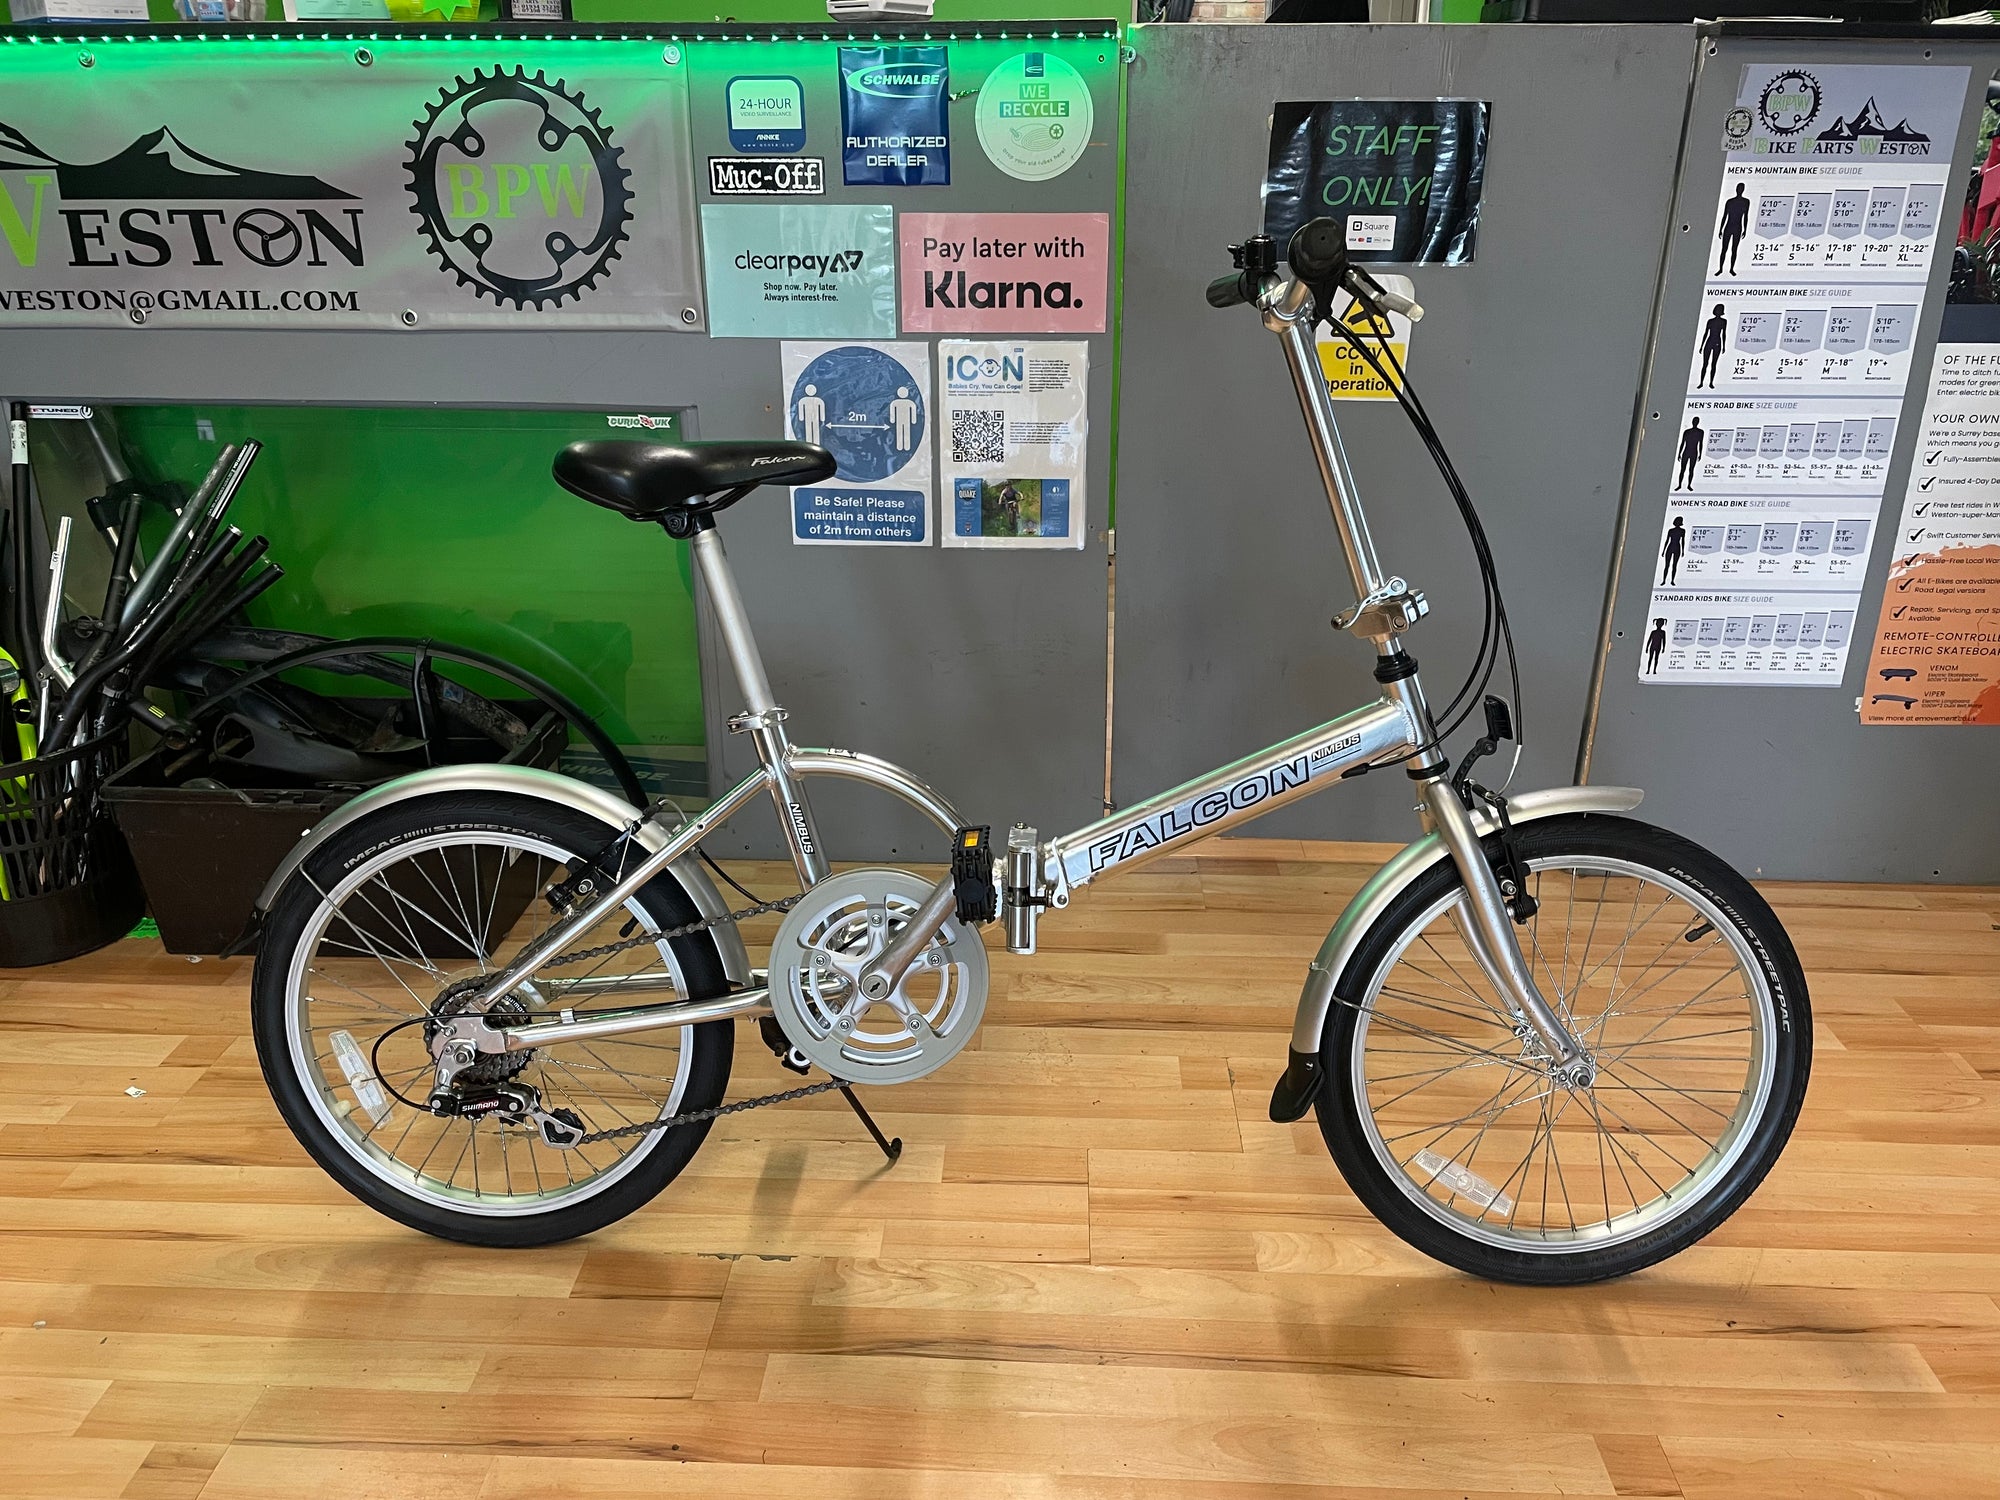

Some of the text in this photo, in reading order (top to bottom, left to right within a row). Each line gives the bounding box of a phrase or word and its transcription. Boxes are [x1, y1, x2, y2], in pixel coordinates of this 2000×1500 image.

[863, 73, 940, 86] SCHWALBE
[1022, 84, 1047, 98] WE
[740, 98, 792, 109] 24-HOUR
[1767, 94, 1812, 113] BPW
[1003, 103, 1066, 117] RECYCLE
[846, 135, 947, 150] AUTHORIZED
[1325, 125, 1441, 156] STAFF
[1753, 136, 1932, 155] BIKE PARTS WESTON
[866, 154, 929, 168] DEALER
[716, 162, 820, 190] Muc-Off
[1727, 167, 1862, 175] MEN'S MOUNTAIN BIKE SIZE GUIDE
[447, 162, 594, 221] BPW
[1322, 175, 1433, 207] ONLY!
[1364, 222, 1389, 231] Square
[923, 235, 1085, 262] Pay later with
[1752, 253, 1764, 261] XS
[1789, 253, 1795, 261] S
[1825, 253, 1833, 261] M
[1861, 253, 1867, 261] L
[1897, 253, 1908, 261] XL
[735, 249, 830, 278] clearpay
[763, 282, 838, 292] Shop now. Pay later.
[923, 269, 1084, 310] Klarna.
[1707, 289, 1853, 297] WOMEN'S MOUNTAIN BIKE SIZE GUIDE
[764, 293, 839, 303] Always interest-free.
[1944, 355, 1960, 365] OF
[1965, 355, 1987, 365] THE
[947, 355, 1023, 382] ICON
[1350, 362, 1363, 375] in
[1006, 383, 1024, 391] Cope!
[1687, 401, 1798, 409] MEN'S ROAD BIKE SIZE GUIDE
[610, 418, 668, 427] CURIO UK
[849, 411, 867, 422] 2m
[1932, 414, 2000, 424] YOUR OWN
[1957, 430, 1981, 439] Surrey
[1978, 441, 1994, 449] you
[750, 456, 807, 467] Falcon
[1967, 478, 1990, 486] 4-Day
[815, 496, 905, 509] Be Safe! Please
[1670, 500, 1791, 508] WOMEN'S ROAD BIKE SIZE GUIDE
[803, 510, 917, 524] maintain a distance
[809, 525, 912, 538] of 2m from others
[1936, 587, 1955, 595] Legal
[1654, 595, 1773, 603] STANDARD KIDS BIKE SIZE GUIDE
[1880, 646, 1933, 656] ELECTRIC
[1311, 733, 1360, 761] NIMBUS
[561, 764, 670, 781] HWABE
[1088, 756, 1310, 873] FALCON
[789, 803, 815, 854] NIMBUS
[344, 823, 553, 869] IMPAC STREETPAC
[1667, 867, 1791, 1033] IMPAC STREETPAC
[461, 1100, 499, 1112] SHIMANO
